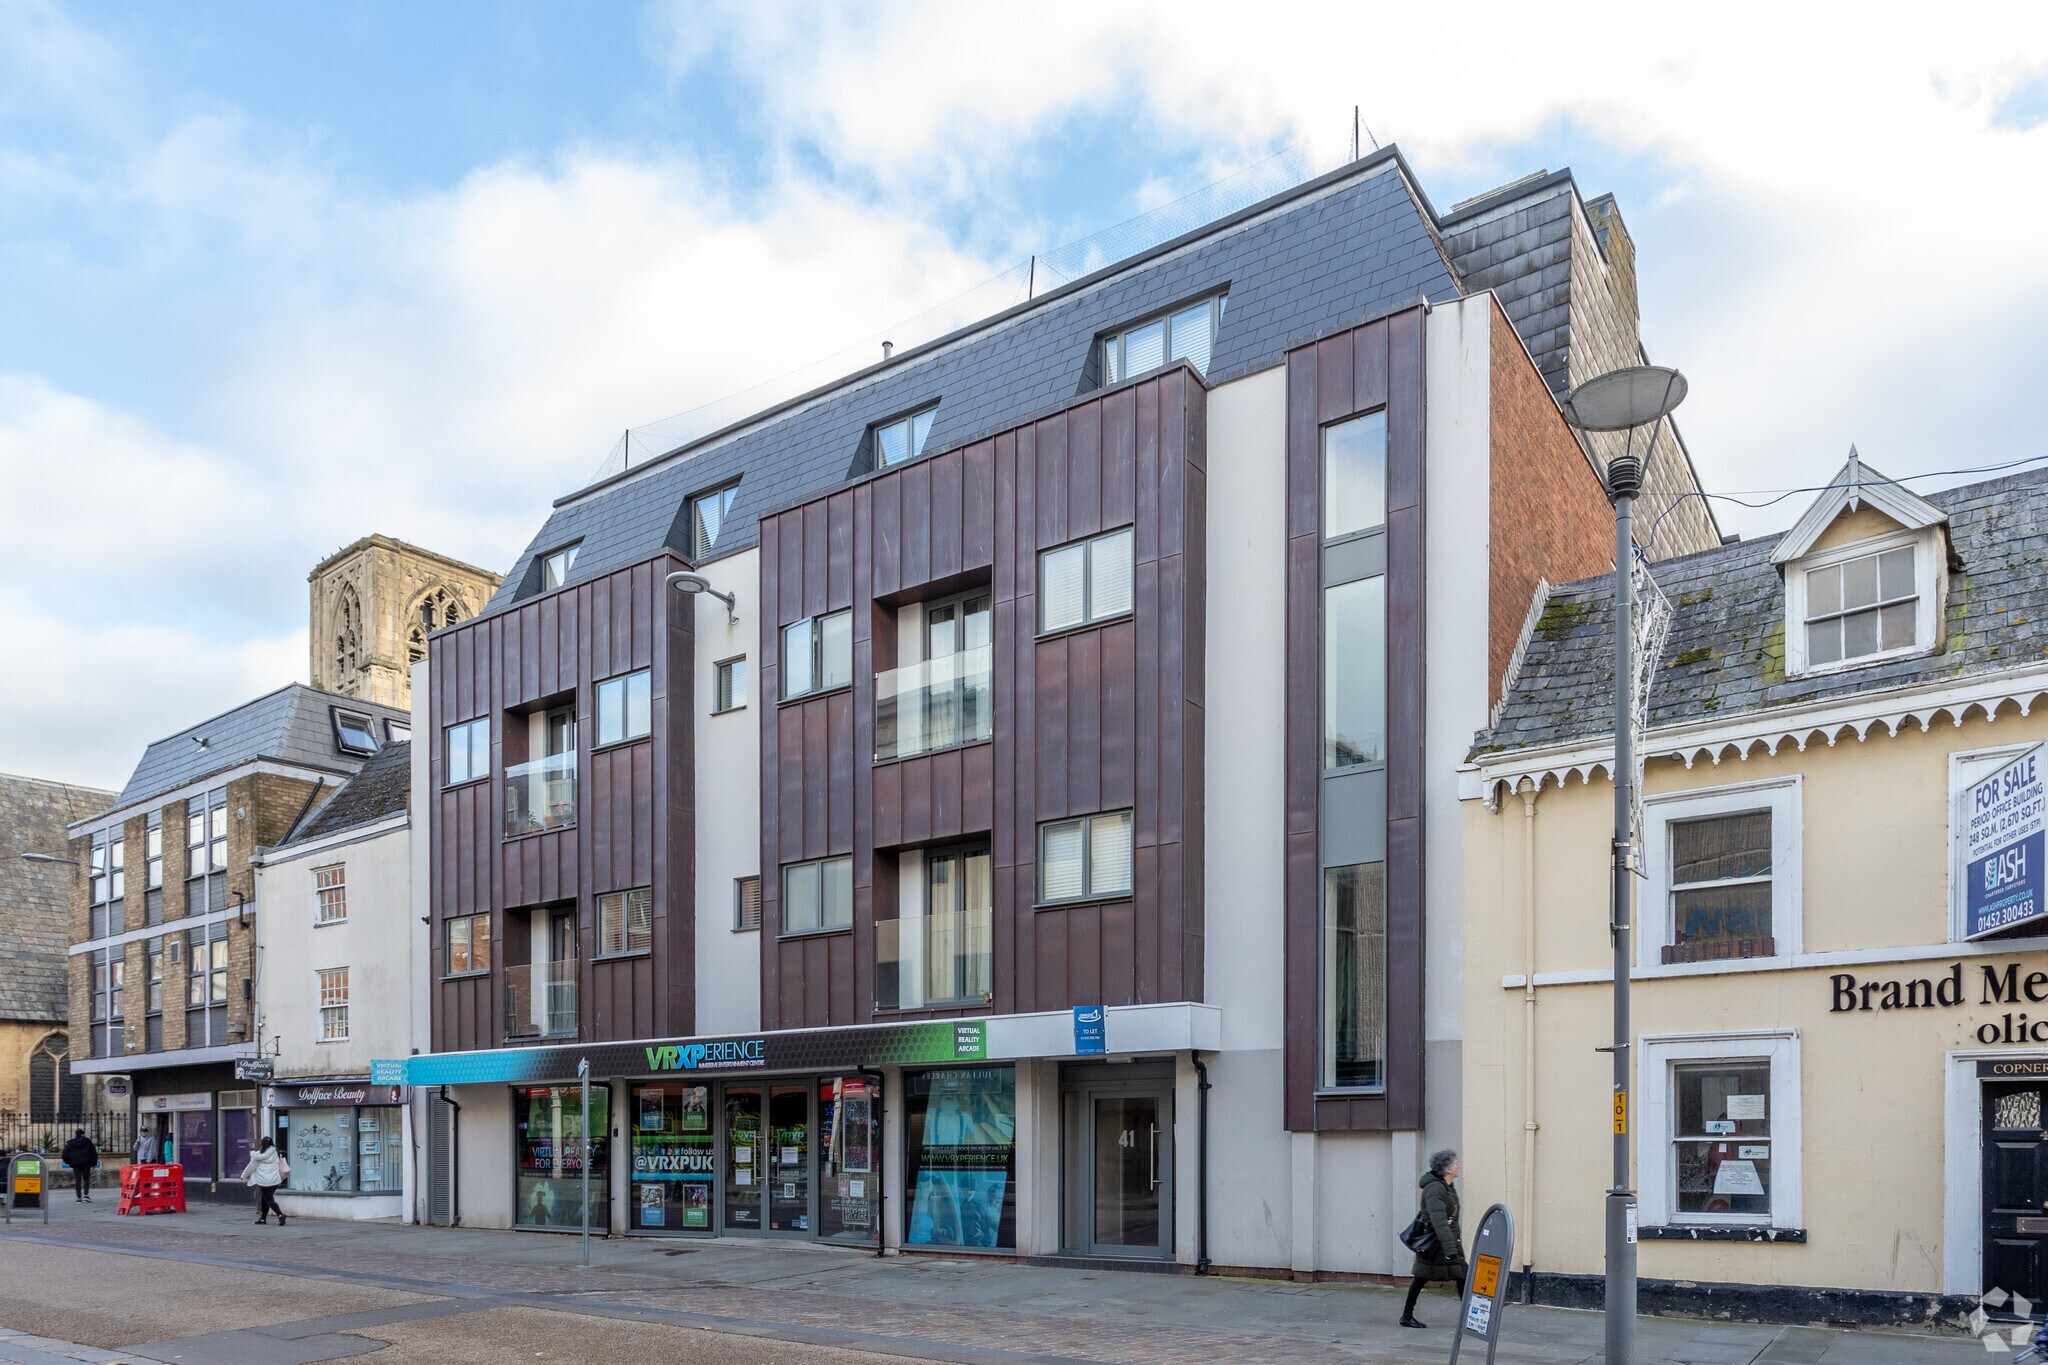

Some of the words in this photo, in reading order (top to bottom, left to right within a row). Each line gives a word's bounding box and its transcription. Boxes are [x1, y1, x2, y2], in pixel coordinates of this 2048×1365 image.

[1975, 778, 2000, 813] FOR
[2003, 755, 2036, 797] SALE
[1970, 809, 1990, 831] PERIOD
[1992, 799, 2011, 819] OFFICE
[2013, 782, 2043, 808] BUILDING
[1969, 831, 1980, 847] 248
[1972, 842, 1993, 858] POTENTIAL
[1994, 838, 2003, 847] FOR
[2003, 829, 2017, 843] OTHER
[2018, 823, 2029, 836] USES
[1997, 844, 2026, 887] ASH
[1977, 911, 2000, 932] 01452
[2002, 899, 2034, 924] 300433
[1829, 962, 1966, 1013] Brand
[1979, 963, 2048, 1006] Me
[645, 1039, 765, 1071] VRXPERIENCE
[239, 1060, 270, 1070] Dollface
[245, 1069, 265, 1078] Beauty
[298, 1087, 332, 1105] Dollface
[333, 1086, 367, 1103] Beauty
[296, 1139, 315, 1151] Dollface
[1118, 1129, 1135, 1148] 41
[680, 1147, 704, 1156] follow
[535, 1158, 551, 1169] FOR
[634, 1155, 714, 1171] @VRXPUK
